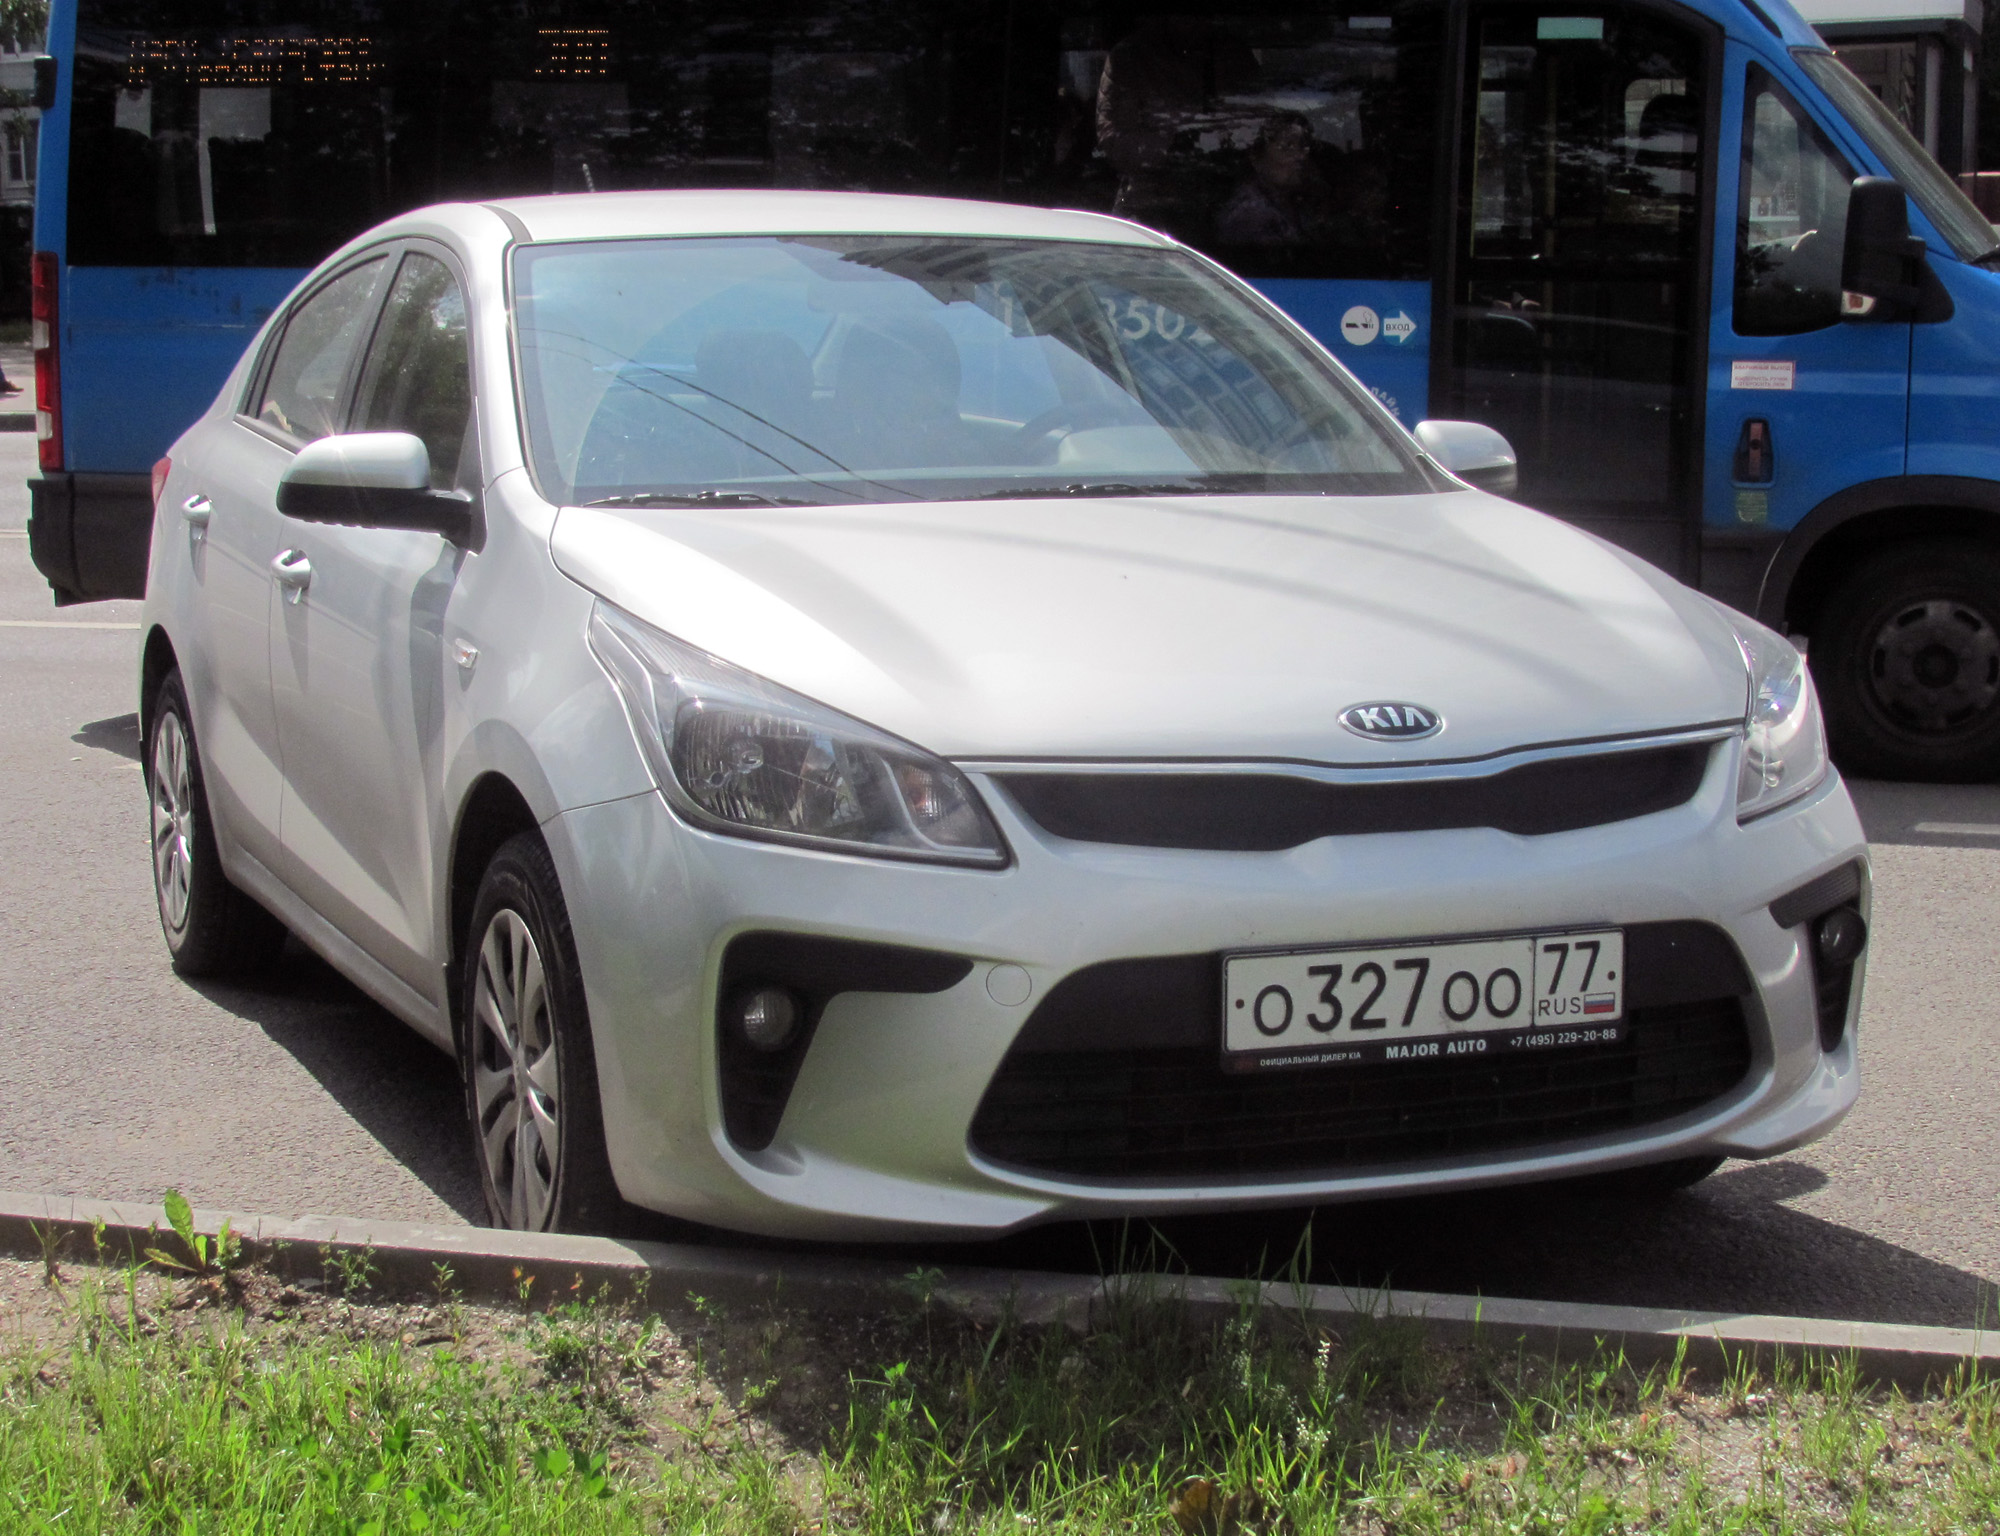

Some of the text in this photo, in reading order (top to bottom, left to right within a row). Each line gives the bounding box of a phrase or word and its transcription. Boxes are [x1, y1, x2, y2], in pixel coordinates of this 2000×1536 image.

[1385, 323, 1410, 331] ВХОД
[1355, 706, 1431, 730] KIA
[1543, 940, 1601, 995] 77
[1537, 996, 1581, 1017] RUS
[1510, 1028, 1617, 1048] +7 (495) 229-20-88
[1386, 1039, 1487, 1059] MAJOR AUTO
[1260, 1052, 1361, 1067] ОФИЦИАЛЬНЫЙ ДИЛЕР KIA
